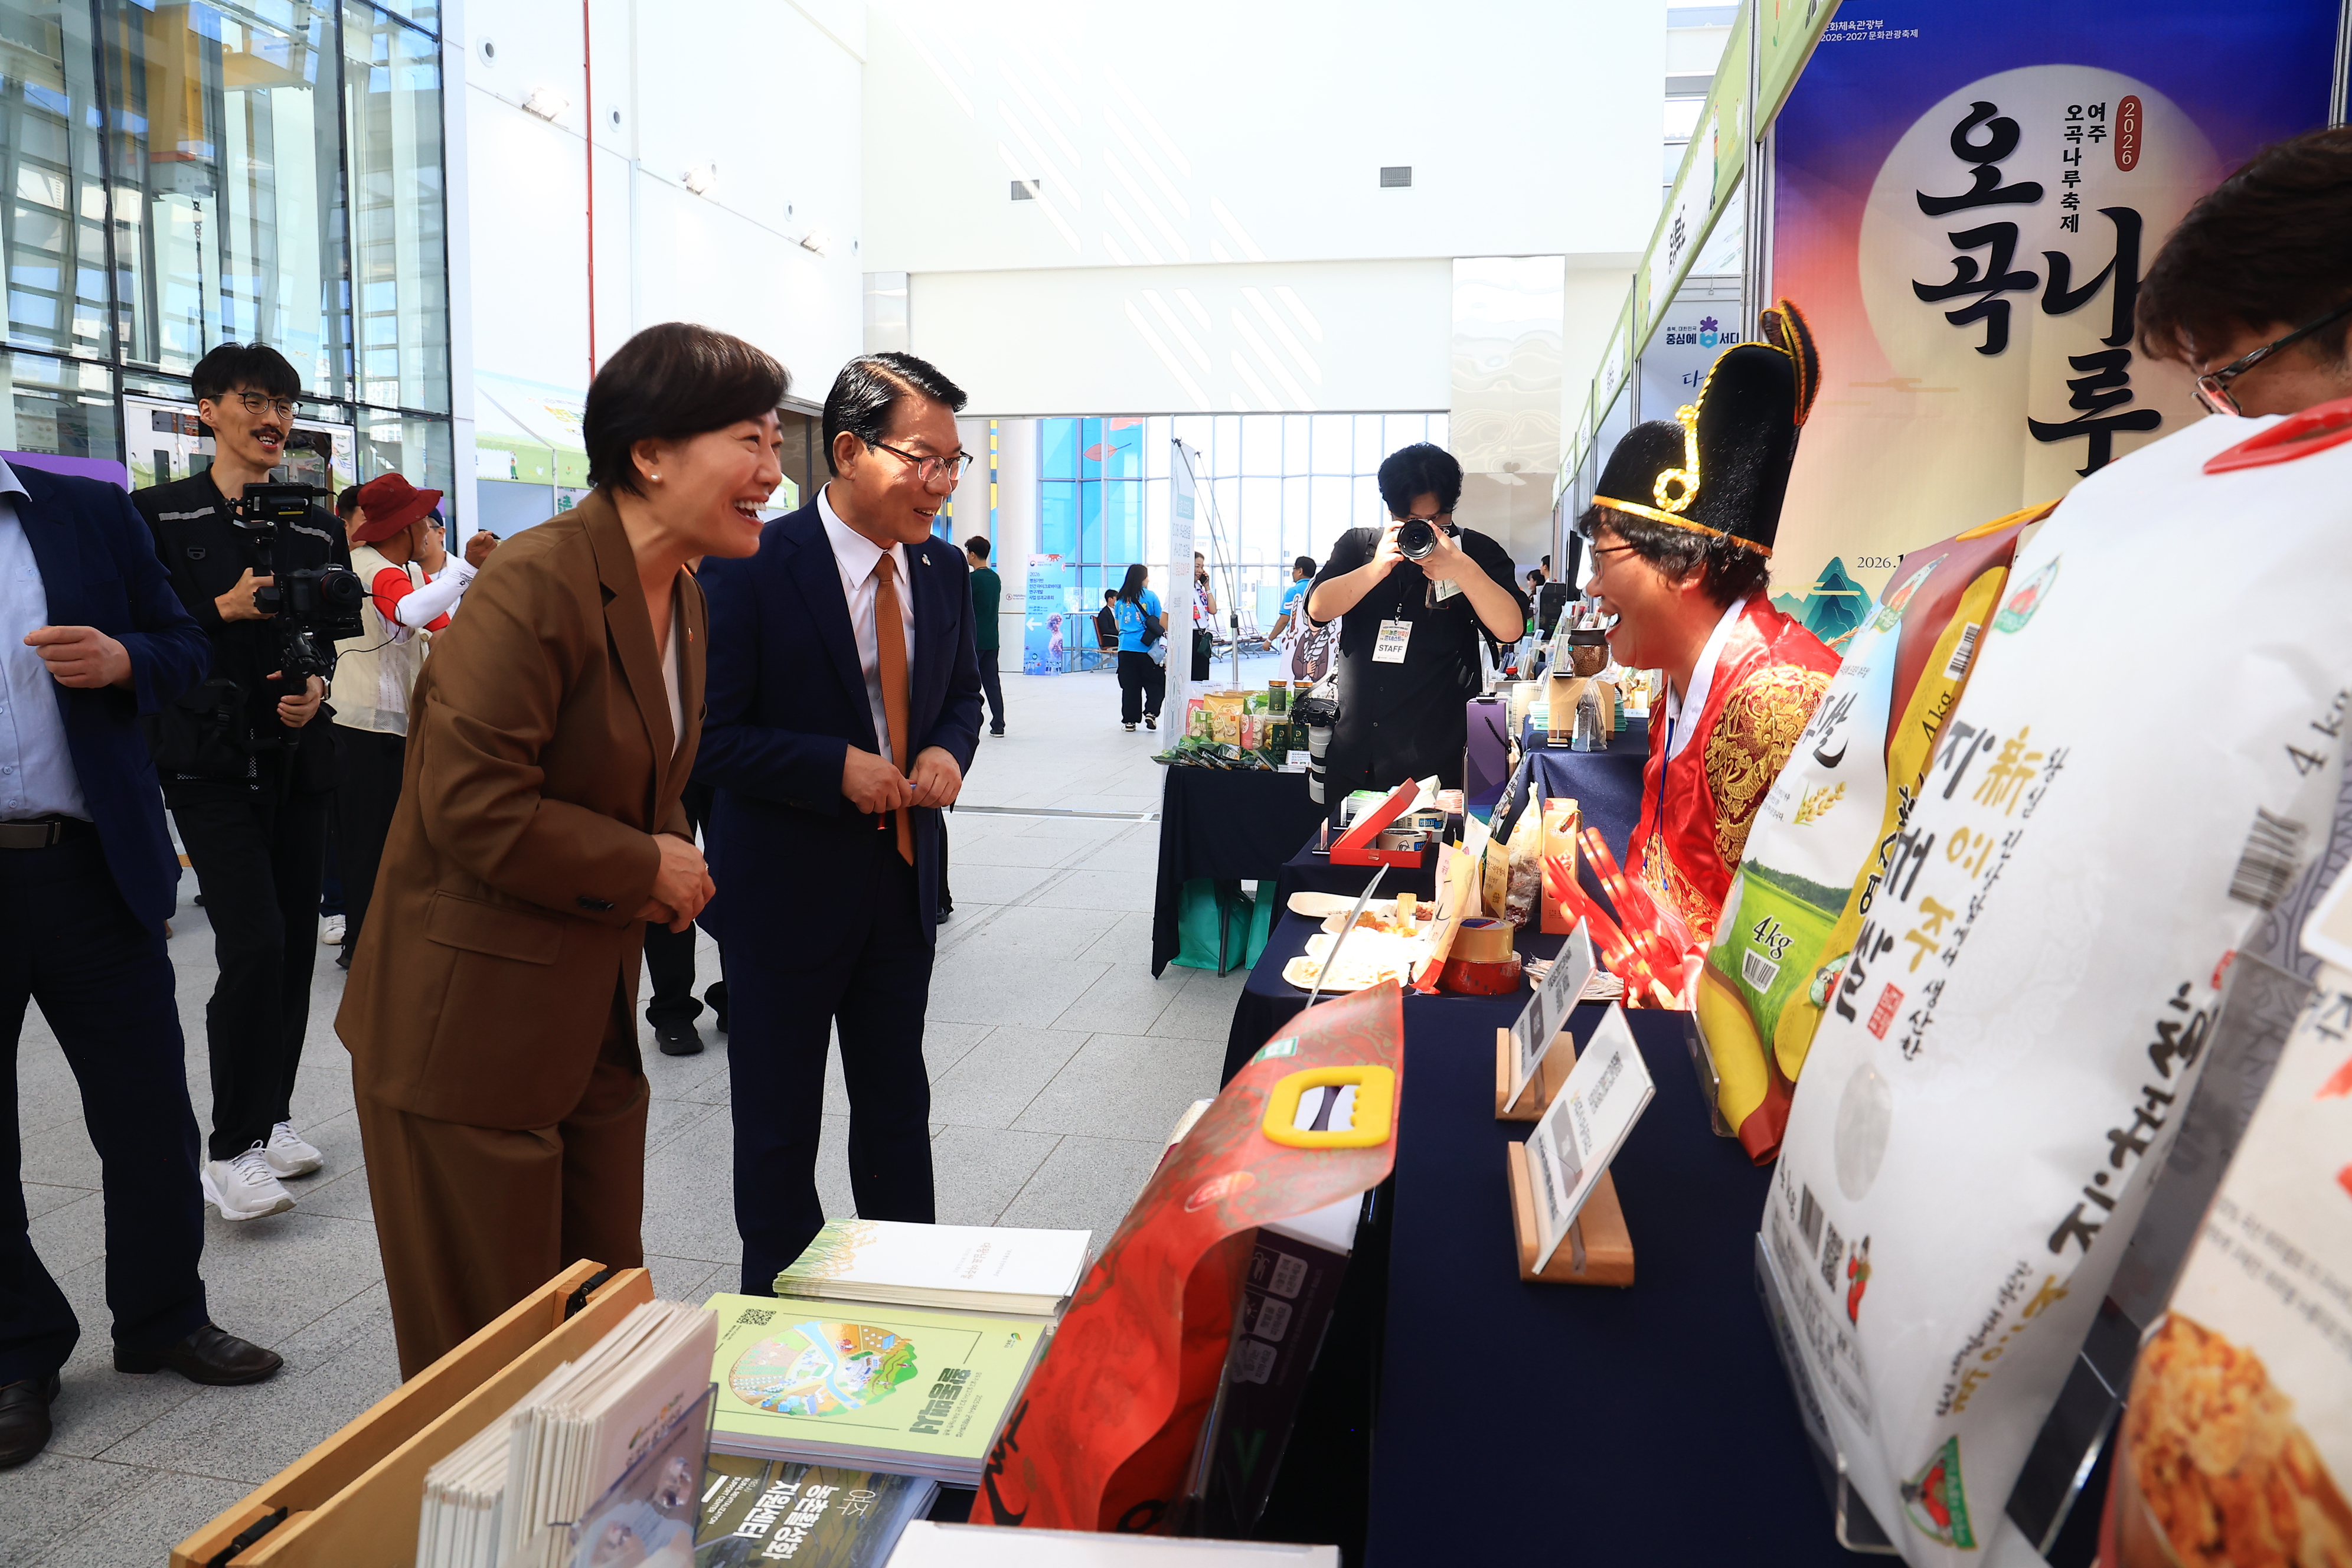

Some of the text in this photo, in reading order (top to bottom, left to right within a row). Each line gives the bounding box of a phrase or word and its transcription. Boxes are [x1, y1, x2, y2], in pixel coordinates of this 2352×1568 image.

[1821, 29, 1918, 42] 2026-2027 문화관광축제
[2087, 102, 2108, 145] 여주
[2124, 102, 2137, 166] 2026
[2060, 104, 2085, 233] 오곡나루축제
[1912, 100, 2043, 355] 오곡
[1666, 333, 1697, 345] 중심에
[1378, 644, 1403, 652] STAFF
[1753, 916, 1793, 960] 4kg
[909, 1368, 971, 1435] 활동백서
[707, 1476, 742, 1513] SUPPORT CENTER
[707, 1477, 751, 1524] RURAL REVITALIZATION
[744, 1479, 759, 1492] YEOJU
[837, 1489, 876, 1517] 여주
[733, 1480, 802, 1539] 지원센터
[761, 1484, 840, 1560] 농촌활성화
